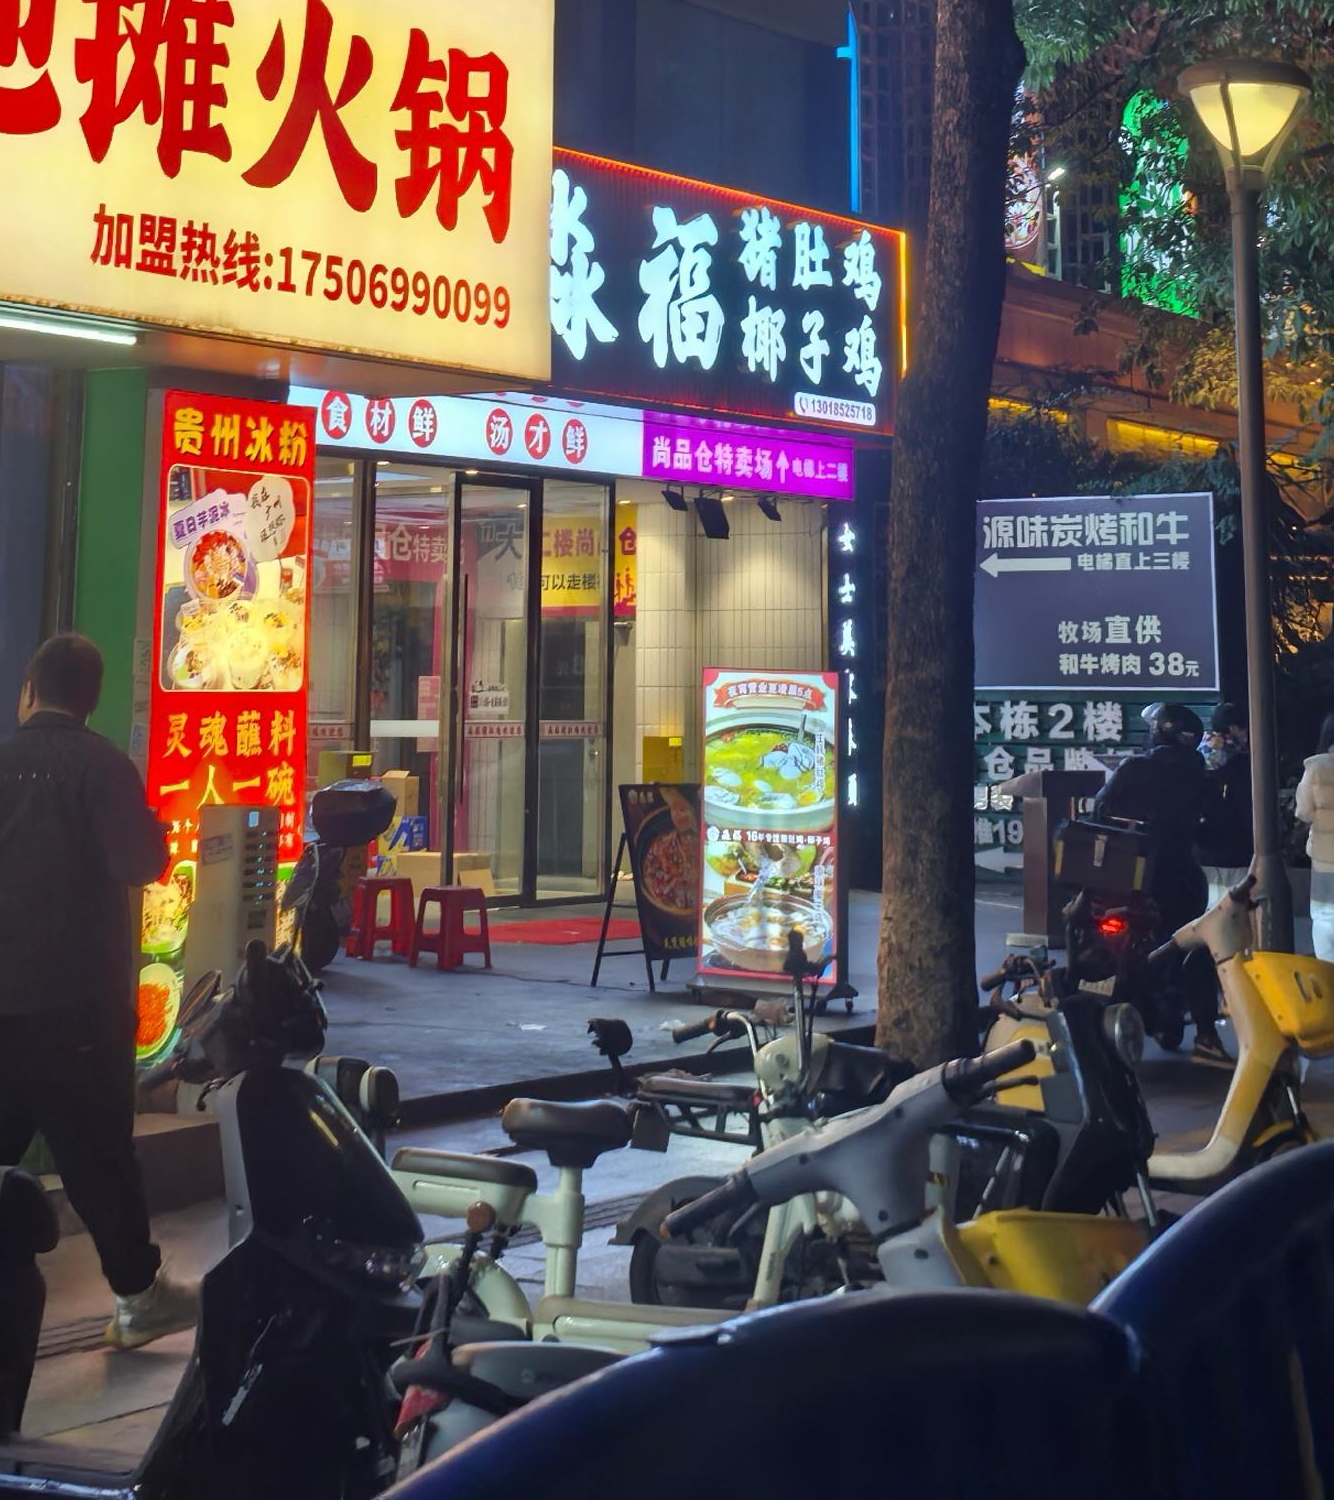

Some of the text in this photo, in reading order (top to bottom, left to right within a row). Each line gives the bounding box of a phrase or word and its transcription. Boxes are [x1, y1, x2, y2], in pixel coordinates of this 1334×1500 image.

[91, 204, 511, 328] 加盟热线:17506990099
[738, 206, 882, 311] 猪肚鸡
[741, 295, 883, 397] 椰子鸡
[326, 396, 585, 458] 食材鲜 汤才鲜
[811, 400, 873, 421] 13018525718
[174, 407, 308, 467] 贵州冰粉
[652, 436, 773, 481] 尚品仓特卖场
[982, 511, 1190, 549] 源味炭烤和牛
[1077, 551, 1190, 571] 电梯直上三楼
[1058, 615, 1162, 644] 牧场直供
[1059, 652, 1200, 677] 和牛烤肉 38元
[162, 710, 296, 758] 灵魂蘸料
[159, 761, 296, 811] 一人一碗
